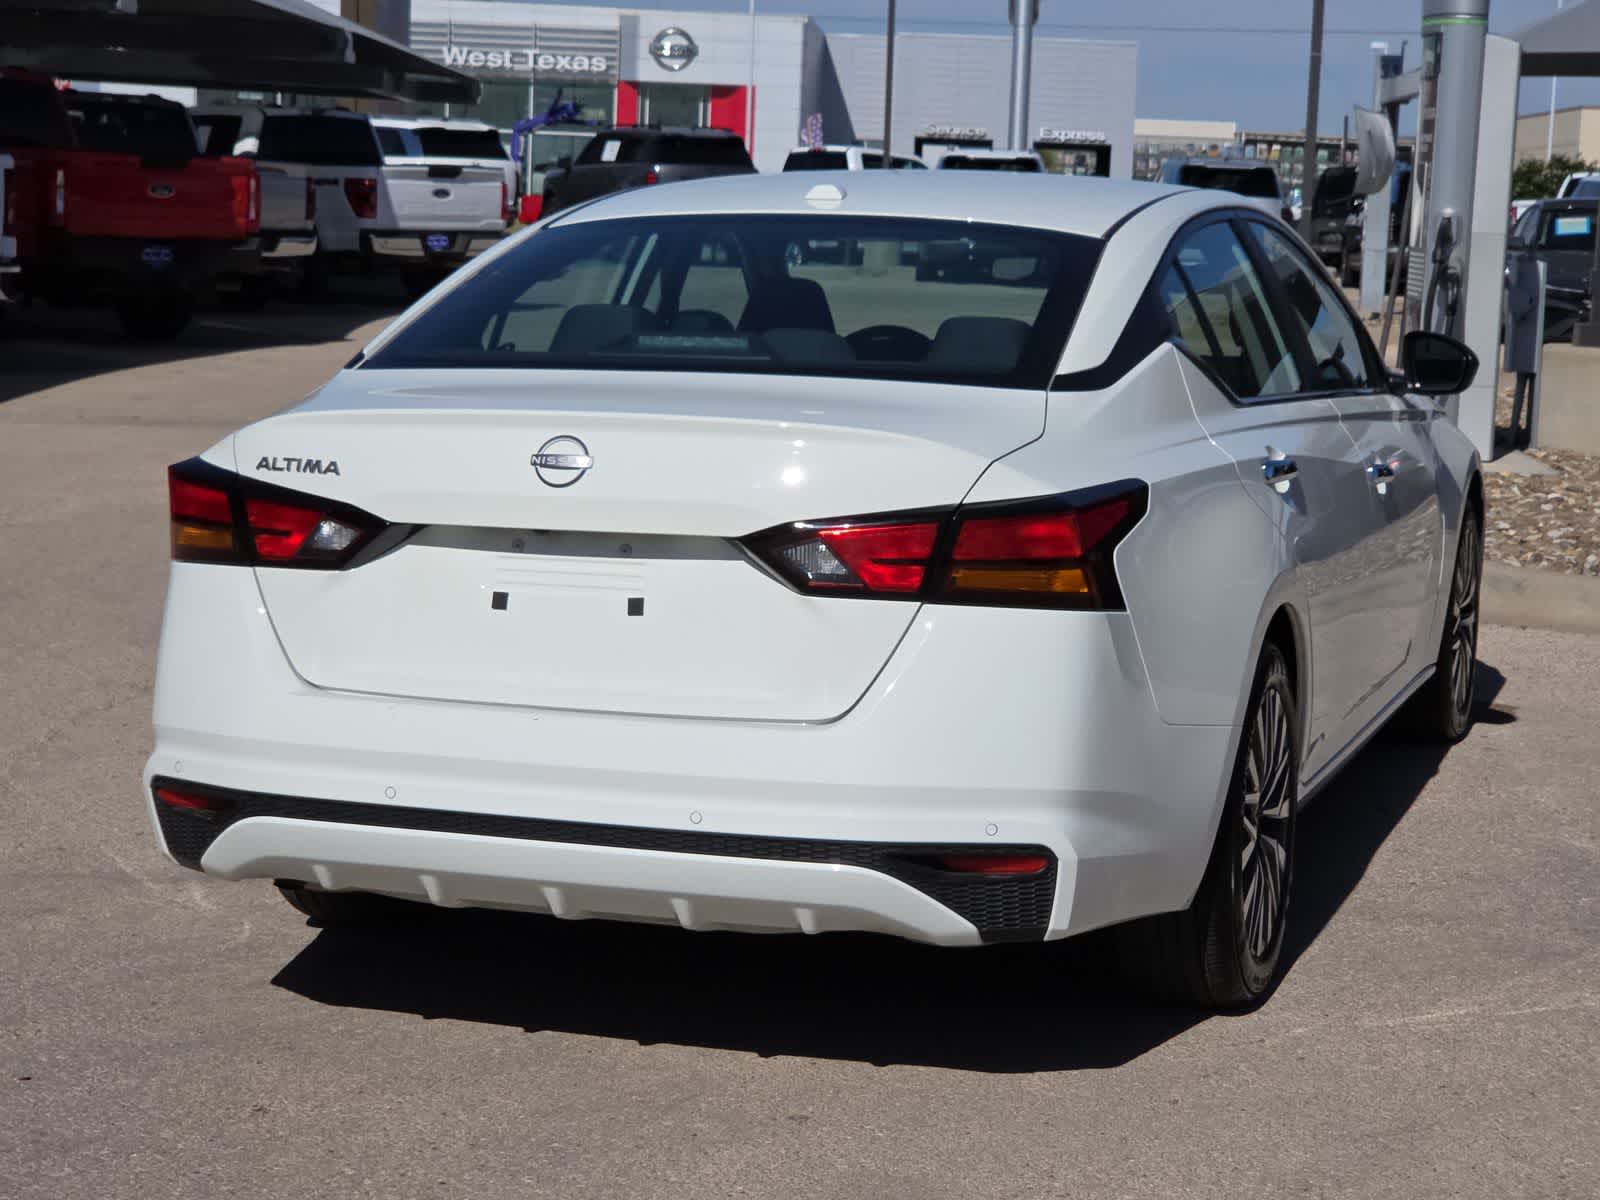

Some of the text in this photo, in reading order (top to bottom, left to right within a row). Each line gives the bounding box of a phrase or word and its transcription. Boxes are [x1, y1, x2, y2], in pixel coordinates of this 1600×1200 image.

[443, 45, 607, 72] West Texas
[1040, 128, 1105, 142] Express
[256, 456, 341, 476] ALTIMA
